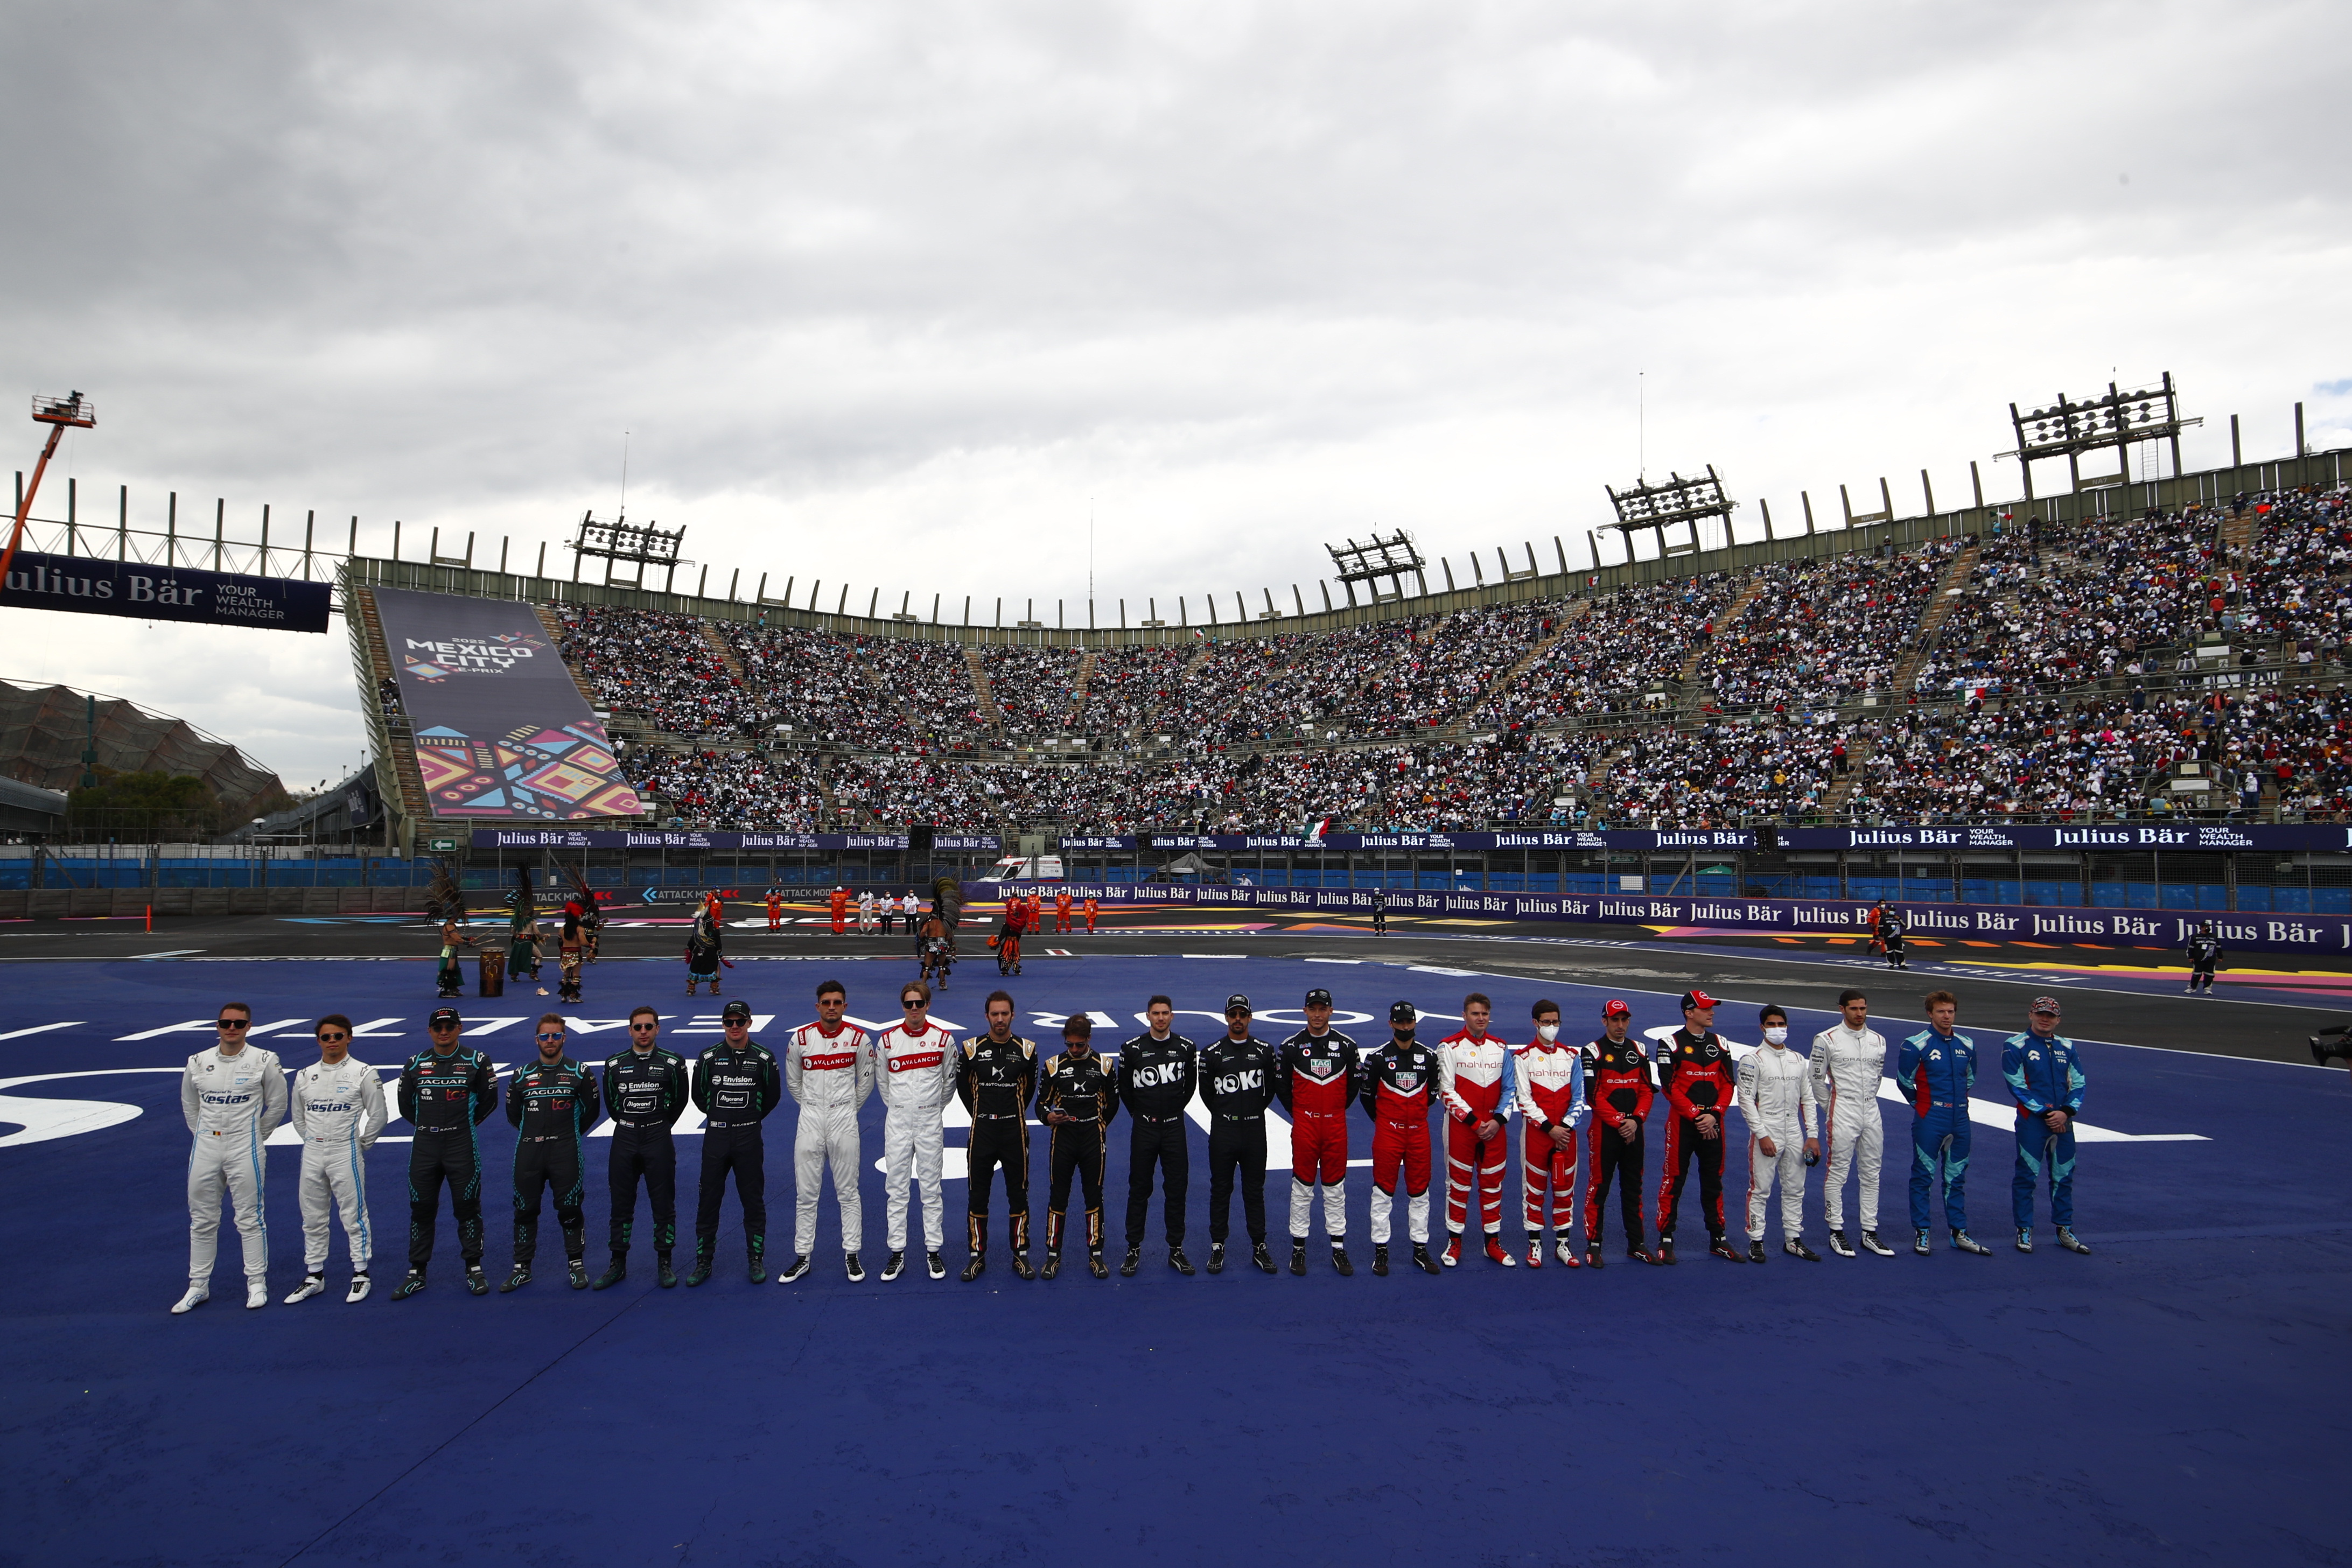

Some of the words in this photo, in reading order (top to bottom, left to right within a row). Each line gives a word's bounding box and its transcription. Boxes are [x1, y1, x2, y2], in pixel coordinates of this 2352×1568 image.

[4, 565, 113, 599] ulius
[128, 575, 202, 606] Bär
[216, 584, 256, 597] YOUR
[216, 594, 272, 608] WEALTH
[216, 606, 284, 619] MANAGER
[406, 638, 533, 657] MEXICO
[436, 654, 516, 668] CITY
[498, 832, 535, 846] Julius
[540, 832, 564, 844] Bär
[626, 833, 661, 847] Julius
[665, 833, 686, 845] Bär
[742, 835, 773, 848] Julius
[776, 835, 796, 846] Bär
[846, 836, 875, 849] Julius
[878, 836, 895, 846] Bär
[934, 837, 961, 849] Julius
[963, 837, 979, 848] Bär
[1088, 838, 1104, 847] Bär
[1151, 837, 1175, 846] ulius
[1178, 837, 1195, 846] Bär
[1247, 837, 1277, 848] Julius
[1281, 836, 1301, 846] Bär
[1361, 835, 1397, 848] Julius
[1402, 835, 1425, 846] Bär
[1496, 834, 1538, 848] Julius
[1543, 834, 1572, 845] Bär
[1656, 832, 1707, 847] Julius
[1713, 832, 1748, 845] Bär
[1850, 830, 1912, 846] Julius
[1919, 830, 1962, 844] Bär
[2055, 829, 2130, 846] Julius
[2138, 828, 2190, 844] Bär
[658, 890, 694, 899] ATTACK
[781, 889, 812, 897] ATTACK
[1038, 886, 1061, 897] Bär
[1106, 887, 1128, 899] Bär
[1134, 887, 1167, 900] Julius
[1171, 887, 1191, 899] Bär
[1196, 888, 1228, 902] Julius
[1231, 890, 1251, 901] Bär
[1256, 891, 1287, 904] Julius
[1291, 892, 1311, 904] Bär
[1317, 892, 1349, 906] Julius
[1352, 894, 1371, 906] Bär
[1418, 895, 1440, 908] Bär
[1445, 896, 1480, 911] Julius
[1483, 897, 1508, 911] Bär
[1516, 898, 1557, 915] Julius
[1562, 900, 1590, 915] Bär
[1599, 901, 1645, 918] Julius
[1650, 902, 1682, 918] Bär
[1691, 903, 1742, 921] Julius
[1748, 905, 1782, 921] Bär
[1793, 906, 1849, 926] Julius
[1906, 909, 1969, 930] Julius
[1976, 912, 2020, 930] Bär
[2033, 914, 2104, 936] Julius
[2112, 916, 2161, 936] Bär
[2267, 921, 2323, 943] Bär
[813, 1057, 853, 1066] AVALANCHE
[901, 1056, 940, 1066] AVALANCHE
[1457, 1061, 1503, 1069] mahindra
[1312, 1067, 1331, 1076] HEUER
[628, 1081, 660, 1089] Envision
[1397, 1080, 1416, 1088] HEUER
[201, 1094, 251, 1104] Vestas
[446, 1089, 467, 1101] tcs
[306, 1103, 352, 1112] Vestas
[551, 1098, 571, 1110] tcs
